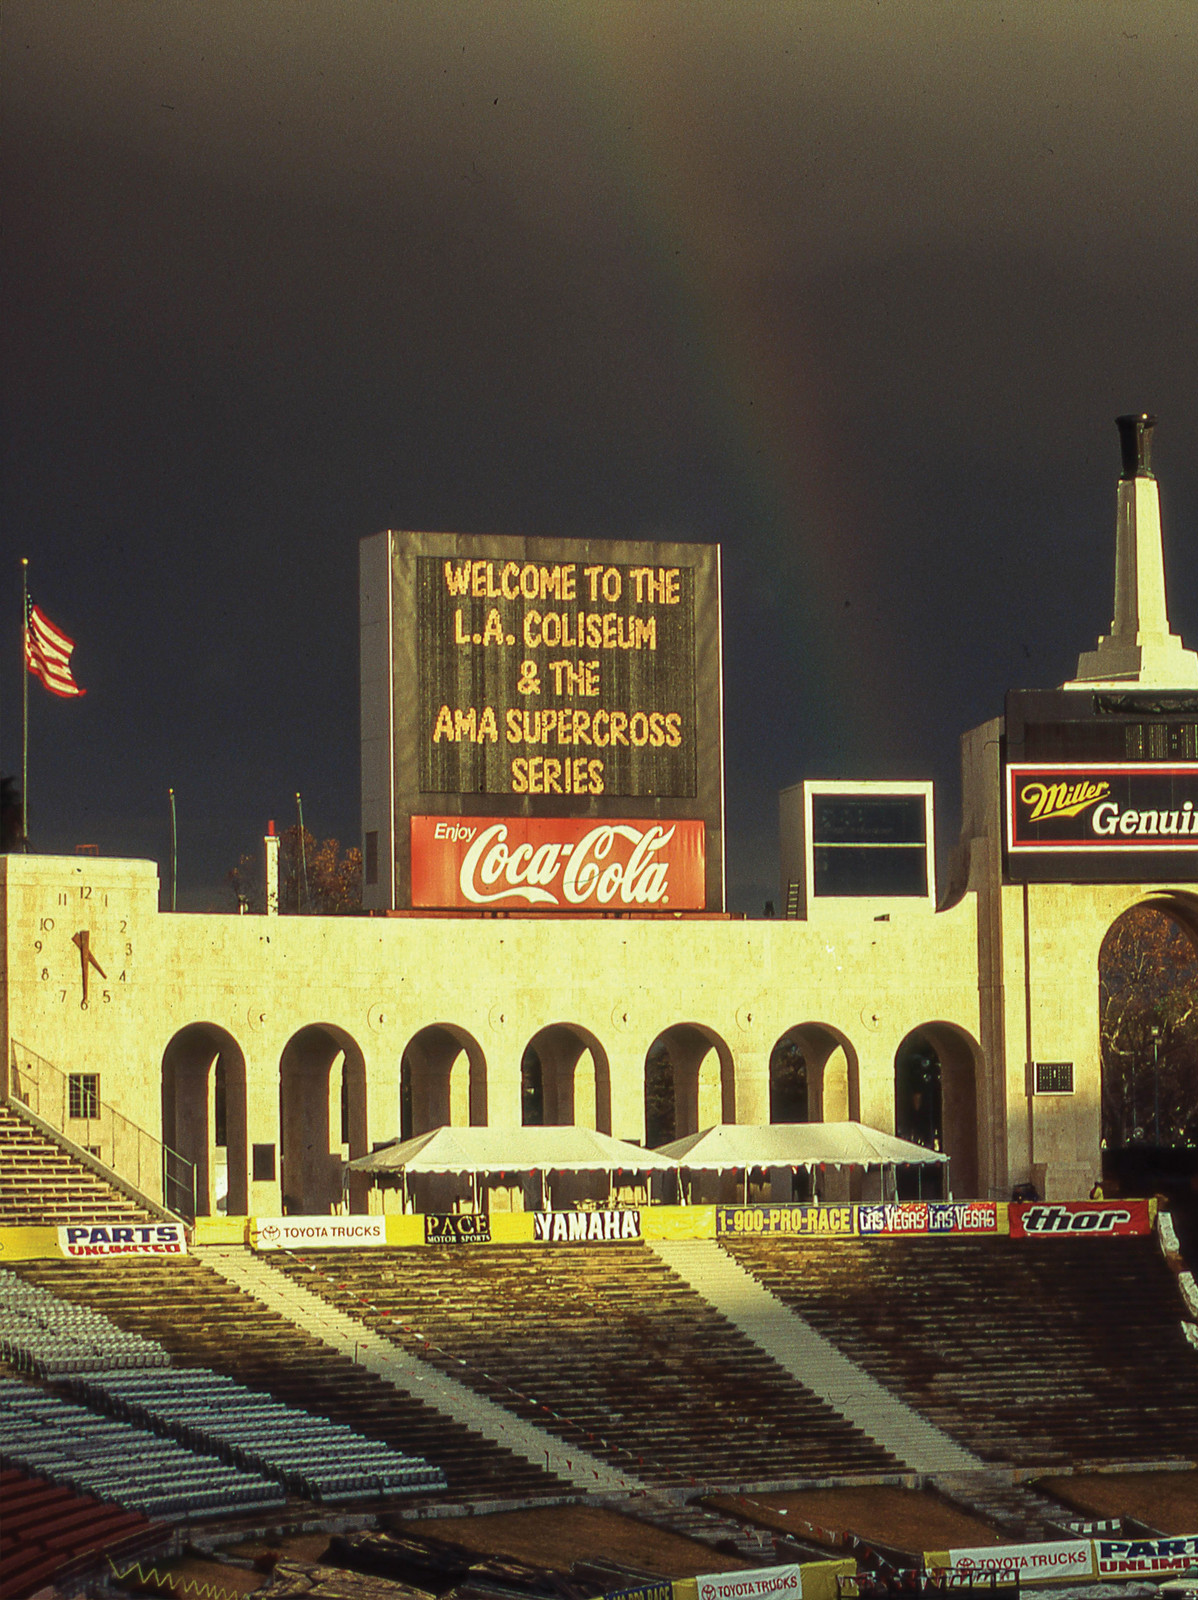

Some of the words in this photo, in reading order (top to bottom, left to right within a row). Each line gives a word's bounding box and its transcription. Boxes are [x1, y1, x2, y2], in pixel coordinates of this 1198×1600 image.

[444, 561, 577, 601] WELCOME
[584, 566, 622, 602] TO
[629, 567, 681, 605] THE
[454, 607, 515, 647] L.A.
[523, 610, 657, 650] COLISEUM
[517, 659, 541, 695] &
[549, 659, 600, 697] THE
[433, 705, 498, 744] AMA
[506, 708, 682, 747] SUPERCROSS
[512, 757, 604, 794] SERIES
[1021, 780, 1111, 822] Miller
[434, 822, 477, 842] Enjoy
[459, 823, 676, 905] Coca-Cola
[58, 893, 67, 906] 11
[80, 886, 92, 899] 12
[40, 917, 55, 932] 10
[119, 920, 127, 934] 2
[34, 940, 43, 954] 9
[125, 942, 133, 956] 3
[41, 967, 49, 981] 8
[119, 970, 126, 982] 4
[59, 989, 67, 1003] 7
[80, 997, 89, 1011] 6
[102, 989, 111, 1004] 5
[426, 1215, 489, 1235] PACE
[535, 1211, 639, 1242] YAMAHA
[718, 1208, 852, 1232] 1-900-PRO-RACE
[859, 1209, 884, 1231] LAS
[886, 1205, 926, 1232] VEGAS
[929, 1208, 953, 1230] LAS
[955, 1205, 995, 1230] VEGAS
[1021, 1205, 1131, 1233] thor
[67, 1226, 179, 1244] PARTS
[283, 1227, 328, 1238] TOYOTA
[331, 1226, 381, 1237] TRUCKS
[427, 1236, 457, 1244] MOTOR
[461, 1234, 491, 1243] SPORTS
[68, 1243, 181, 1256] UNLIMITED
[978, 1556, 1029, 1571] TOYOTA
[1030, 1551, 1088, 1567] TRUCKS
[718, 1582, 755, 1598] TOYOTA
[755, 1576, 799, 1594] TRUCKS
